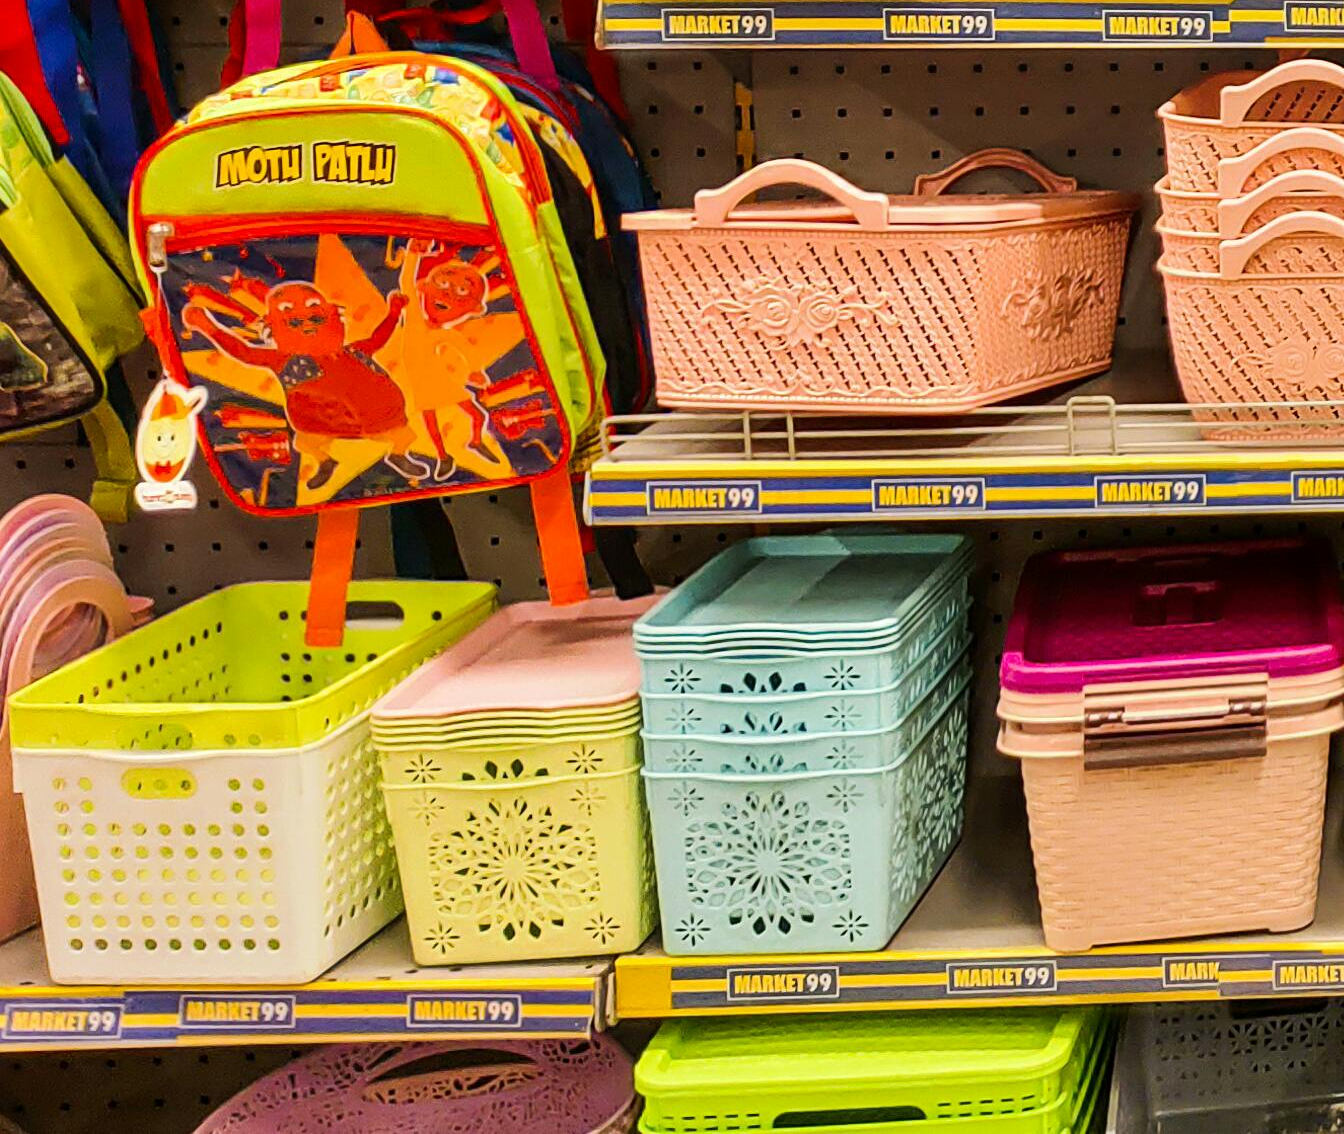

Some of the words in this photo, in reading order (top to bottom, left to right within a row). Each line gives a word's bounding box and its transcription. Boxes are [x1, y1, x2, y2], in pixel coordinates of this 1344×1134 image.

[669, 13, 767, 35] MARKET99
[890, 13, 988, 35] MARKET99
[1109, 15, 1205, 37] MARKET99
[216, 146, 301, 187] MOTU
[313, 141, 396, 184] PATLU
[654, 486, 754, 509] MARKET99
[879, 484, 978, 506] MARKET99
[1102, 480, 1199, 502] MARKET99
[734, 972, 832, 994] MARKET99
[953, 968, 1050, 988] MARKET99
[186, 1000, 289, 1023] MARKET99
[414, 999, 514, 1021] MARKET99
[9, 1010, 115, 1034] MARKET99
